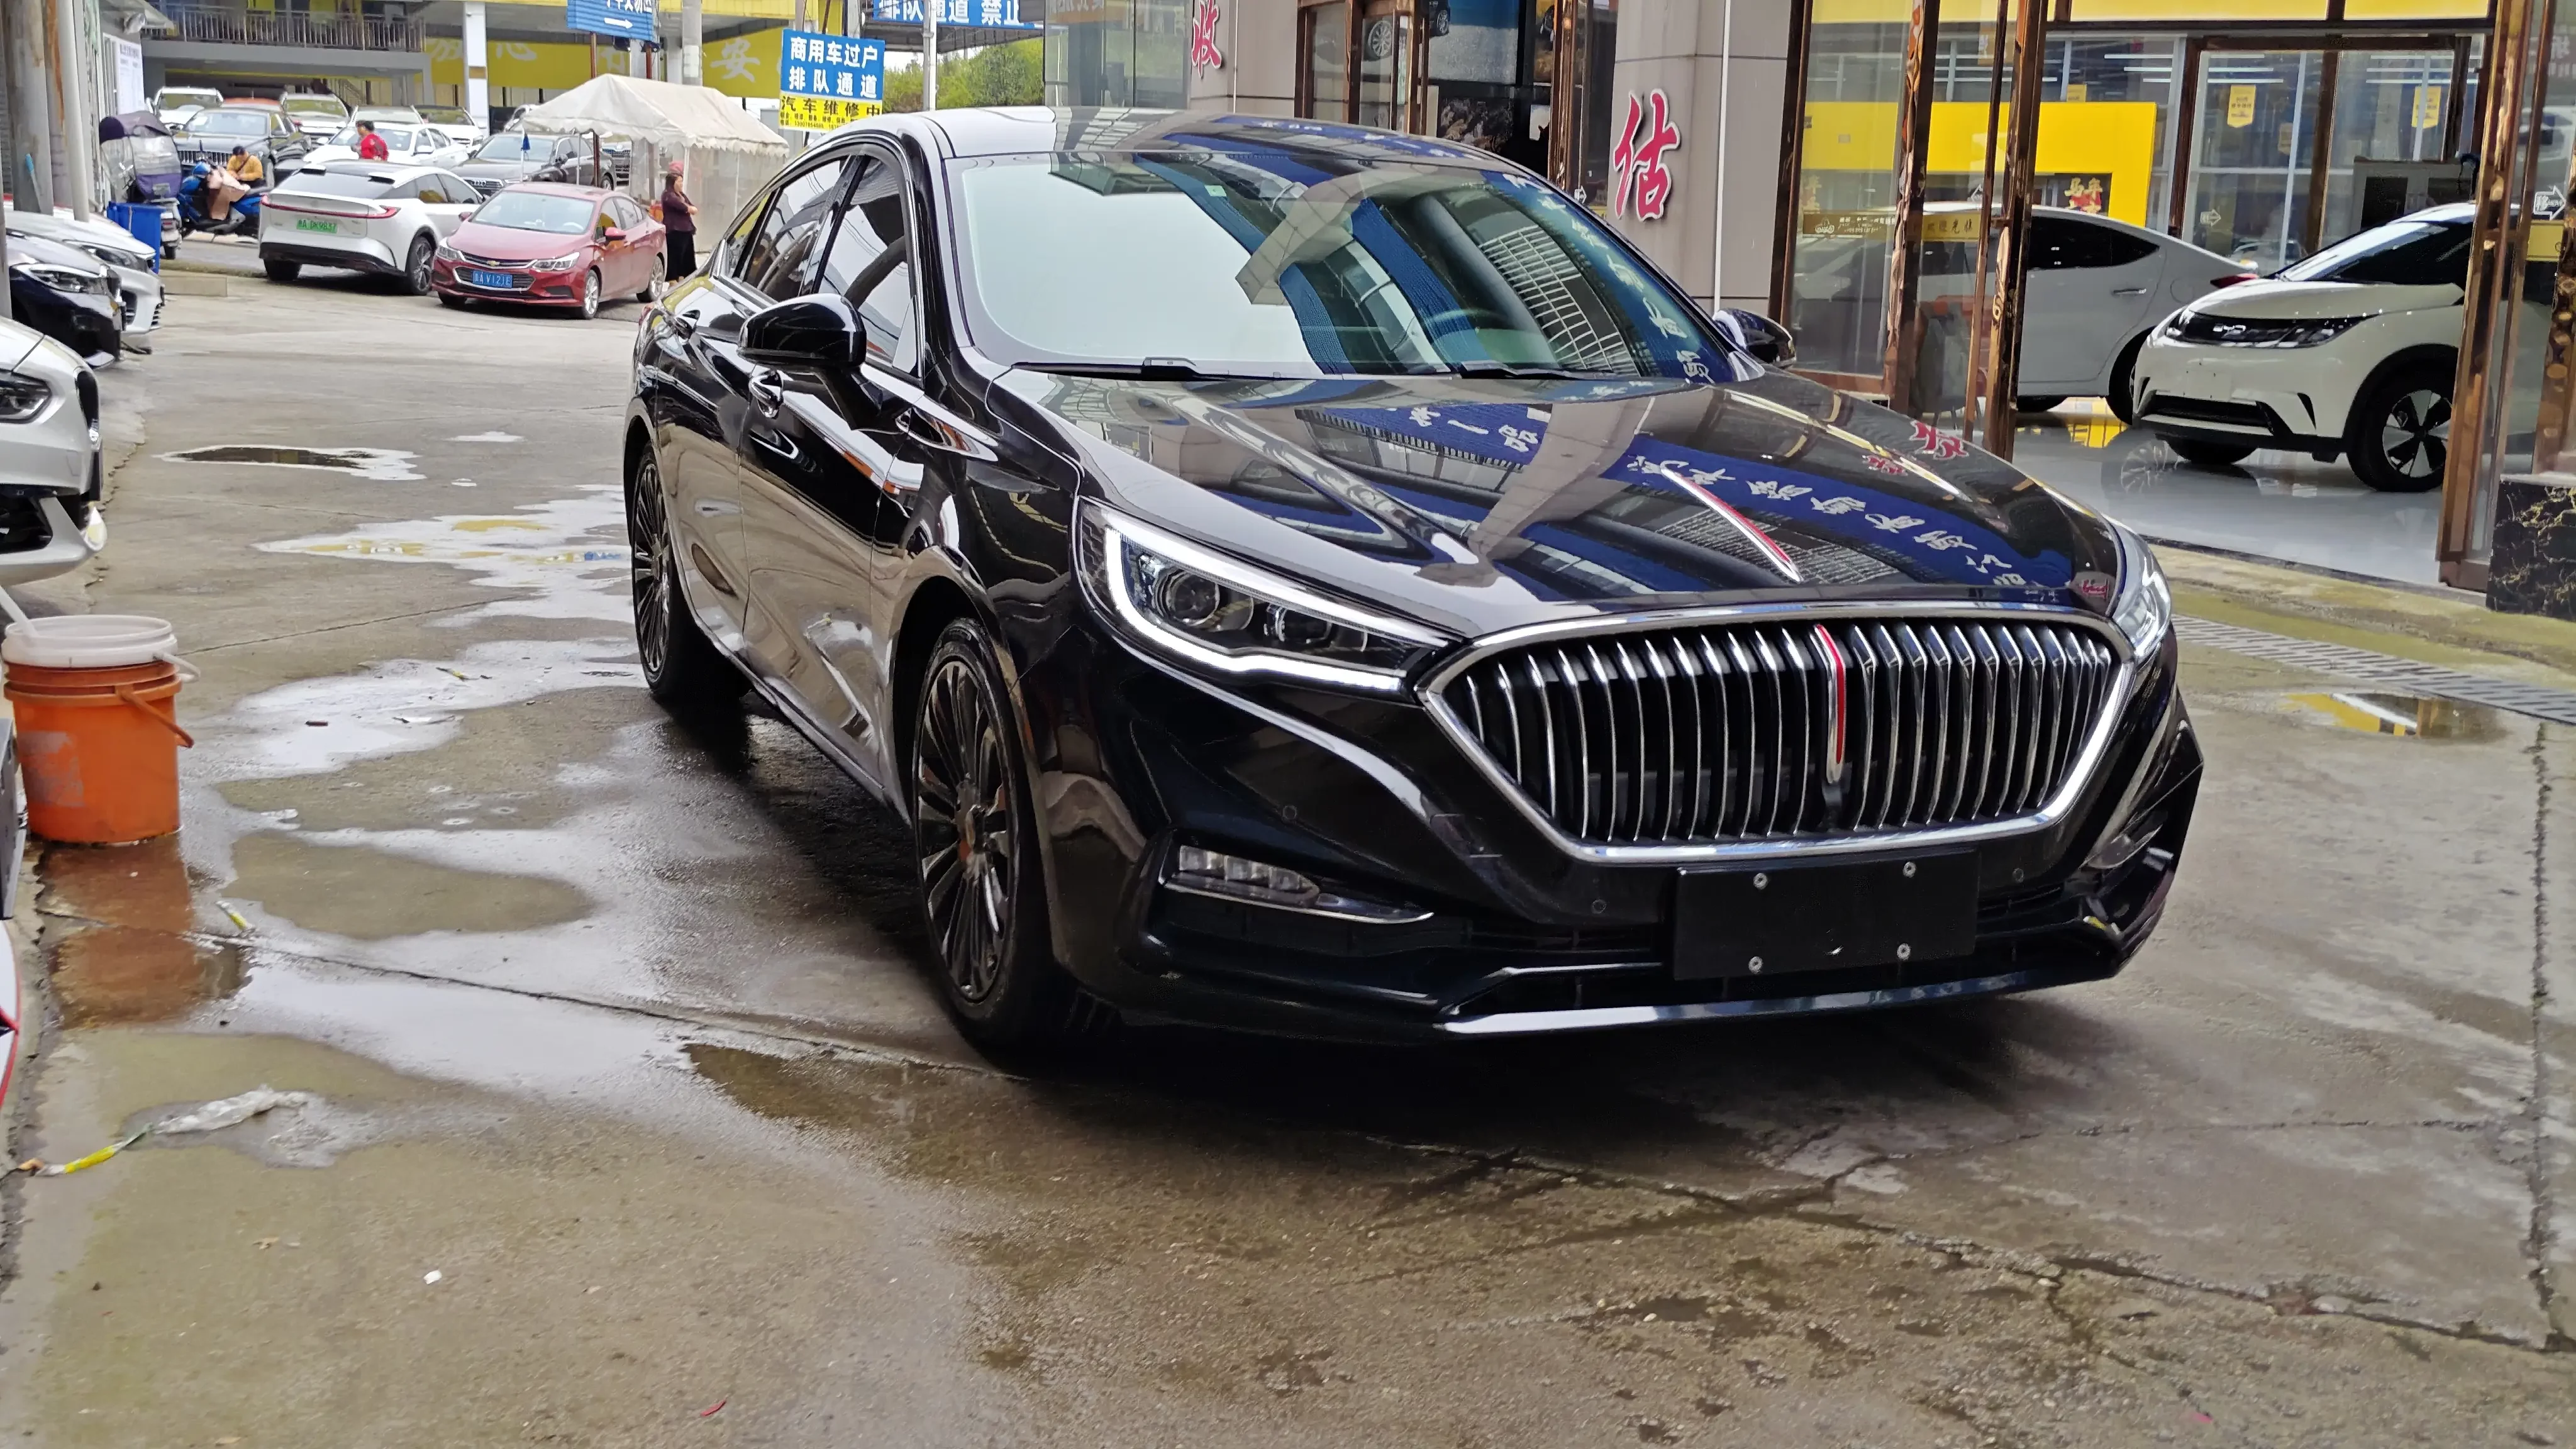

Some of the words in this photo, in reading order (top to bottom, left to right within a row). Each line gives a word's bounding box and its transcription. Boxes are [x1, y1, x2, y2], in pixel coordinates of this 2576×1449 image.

[790, 36, 878, 69] 商用车过户
[788, 65, 877, 99] 排队通道
[781, 95, 880, 117] 汽车维修中
[1613, 88, 1681, 222] 估
